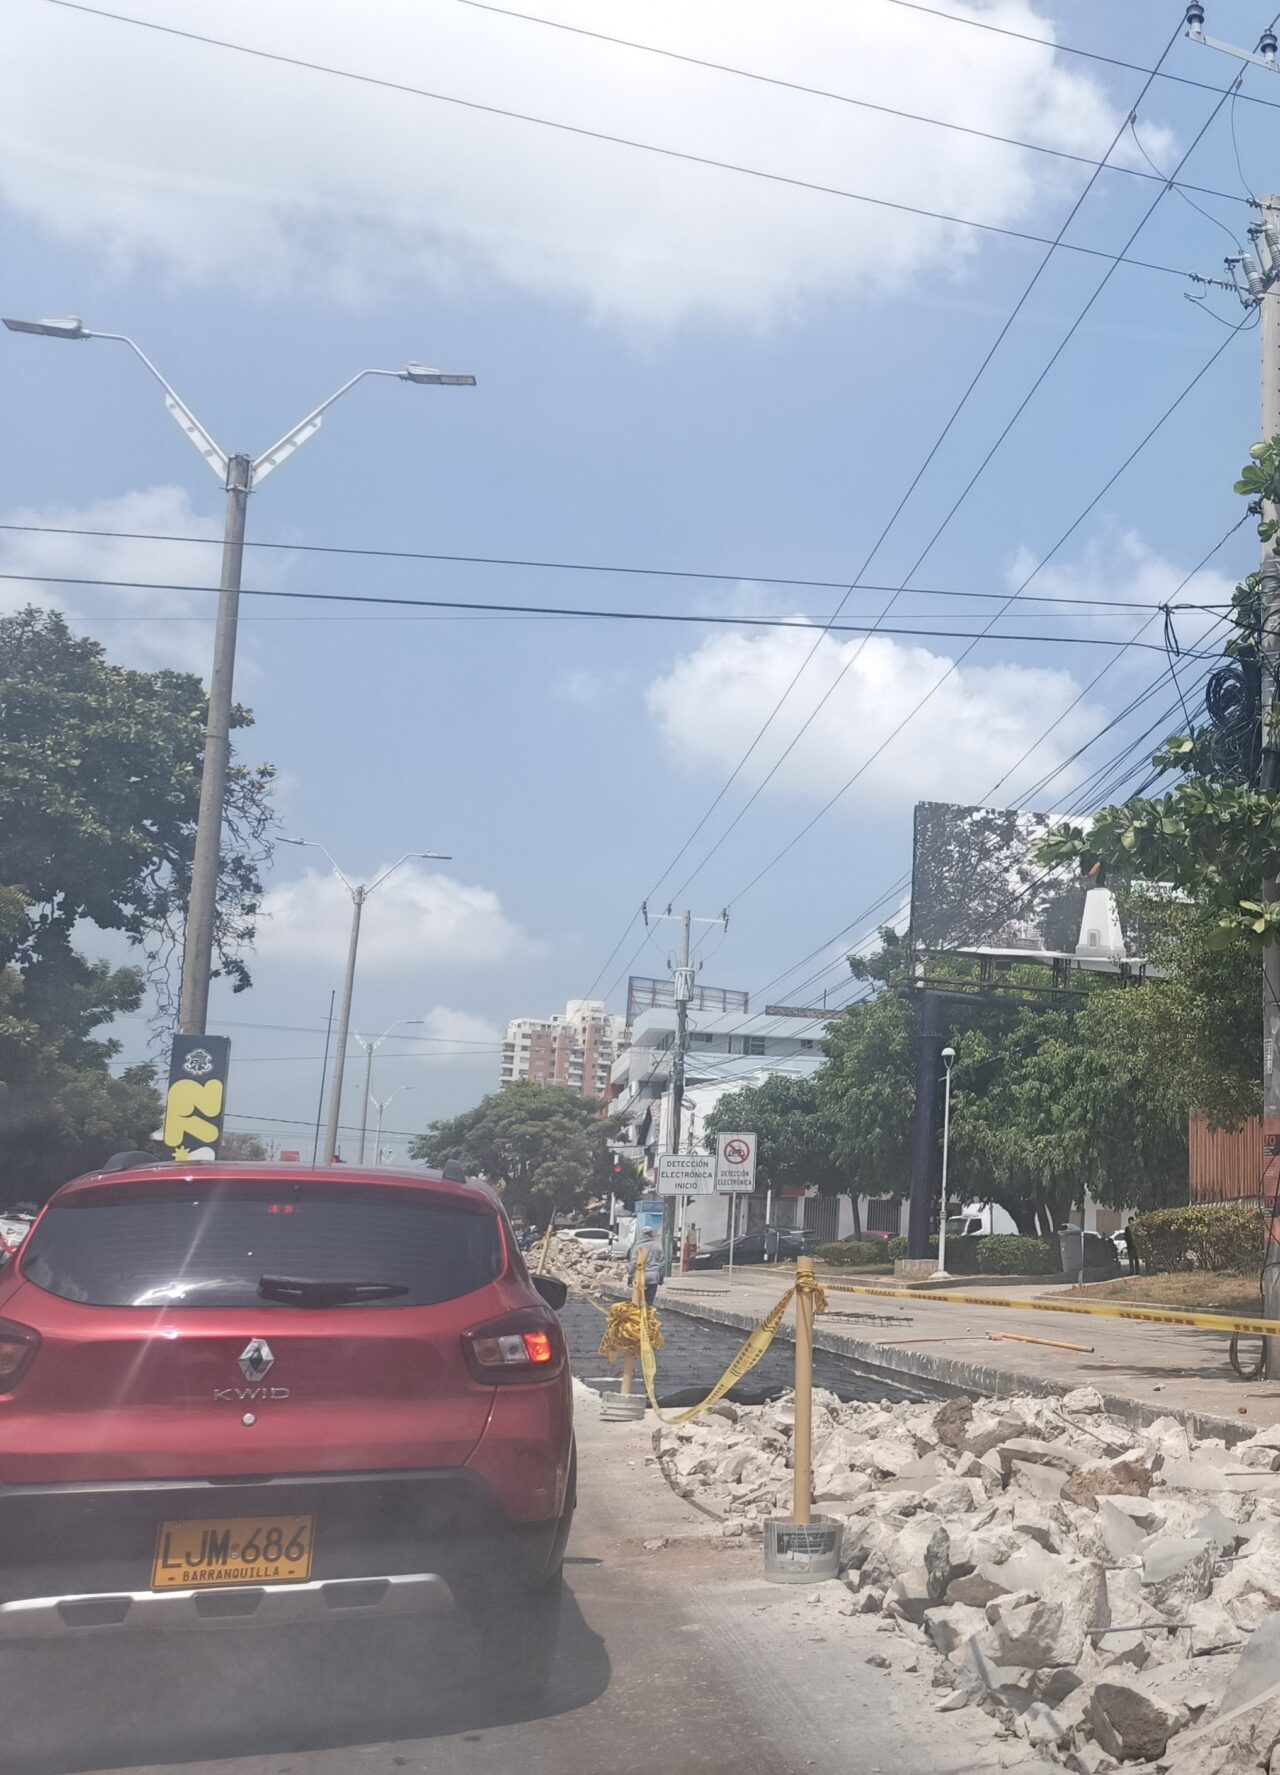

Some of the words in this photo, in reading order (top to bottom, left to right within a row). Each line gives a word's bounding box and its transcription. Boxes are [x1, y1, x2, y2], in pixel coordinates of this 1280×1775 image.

[666, 1159, 709, 1168] DETECCIÓN
[660, 1170, 713, 1179] ELECTRÓNICA
[674, 1182, 698, 1190] INICIO
[213, 1387, 291, 1401] KWID
[240, 1525, 307, 1564] 686
[182, 1566, 280, 1583] BARRANQUILLA
